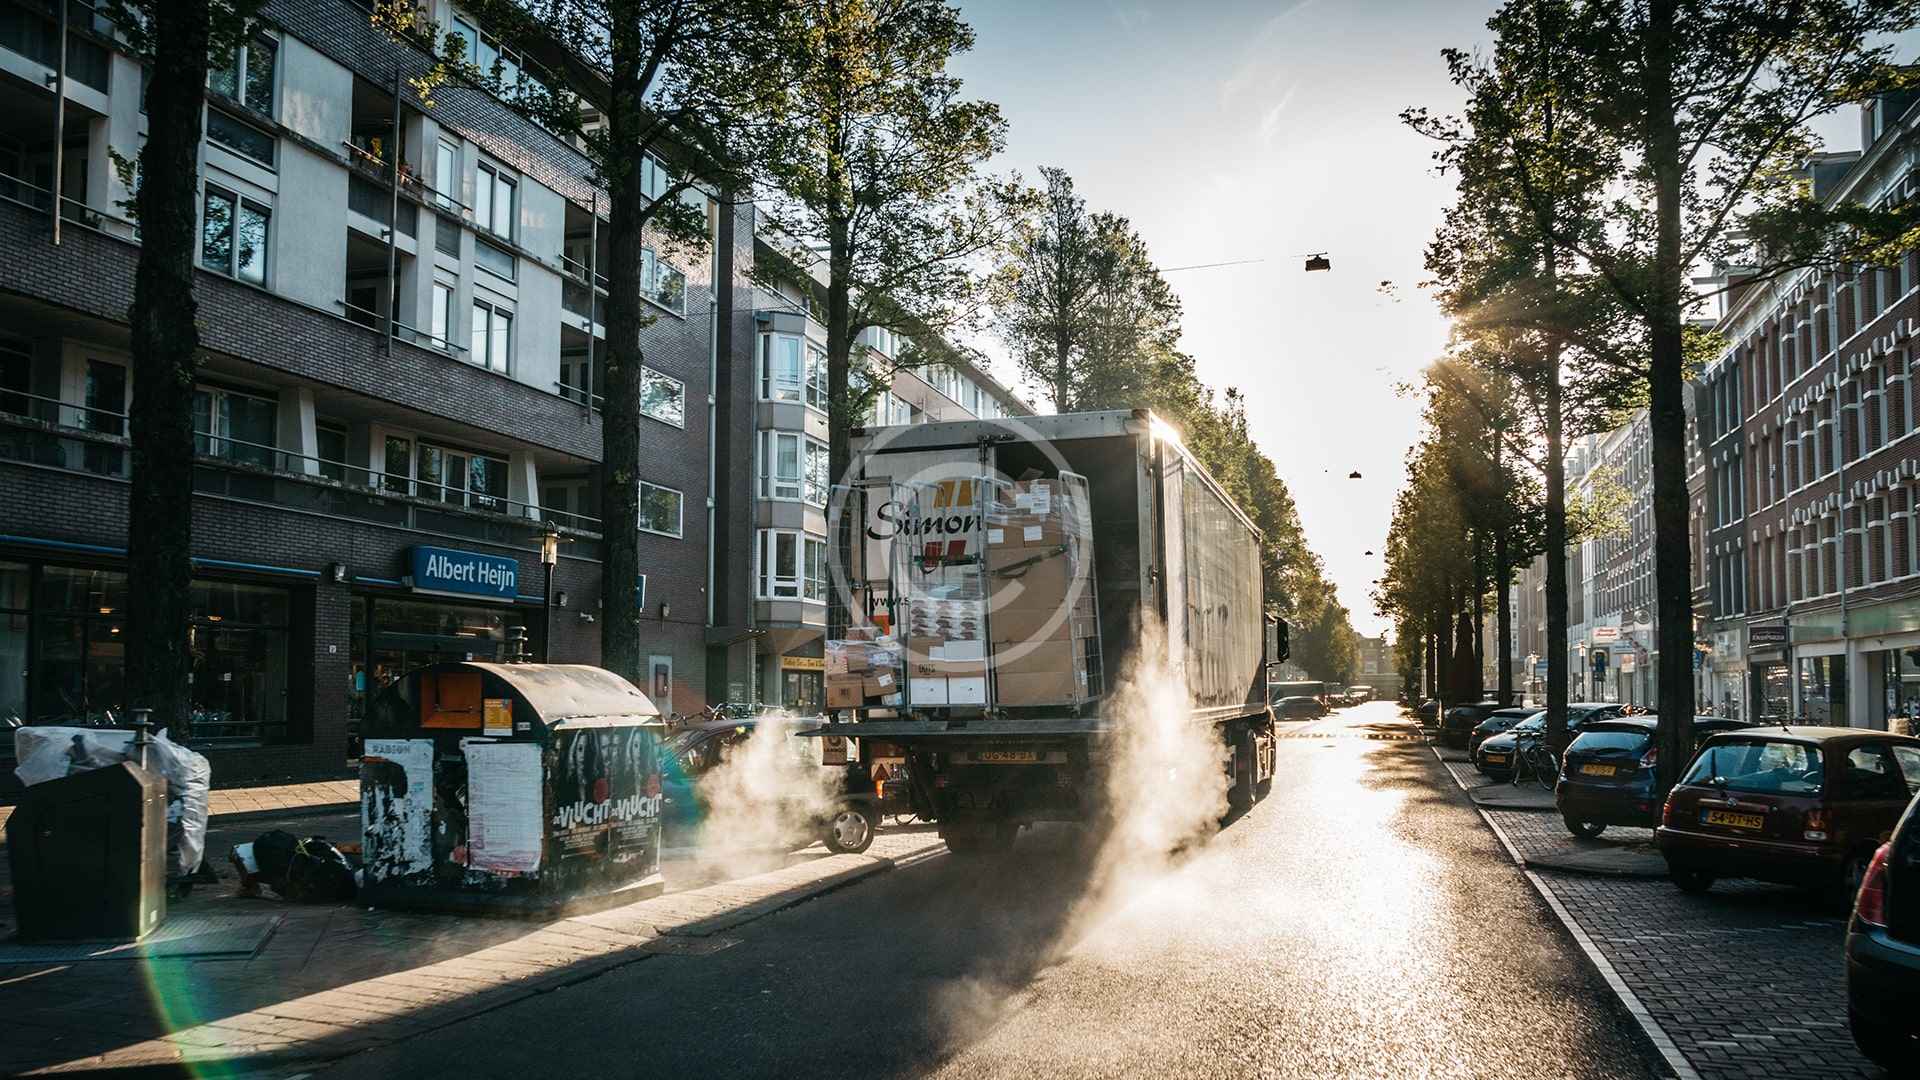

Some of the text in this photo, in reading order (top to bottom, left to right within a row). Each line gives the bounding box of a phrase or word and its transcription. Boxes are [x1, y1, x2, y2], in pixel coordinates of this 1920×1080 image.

[867, 501, 982, 540] Simon
[425, 554, 514, 592] Albert Heijn
[559, 799, 611, 830] VLUCHT
[617, 793, 663, 822] VLUCHT
